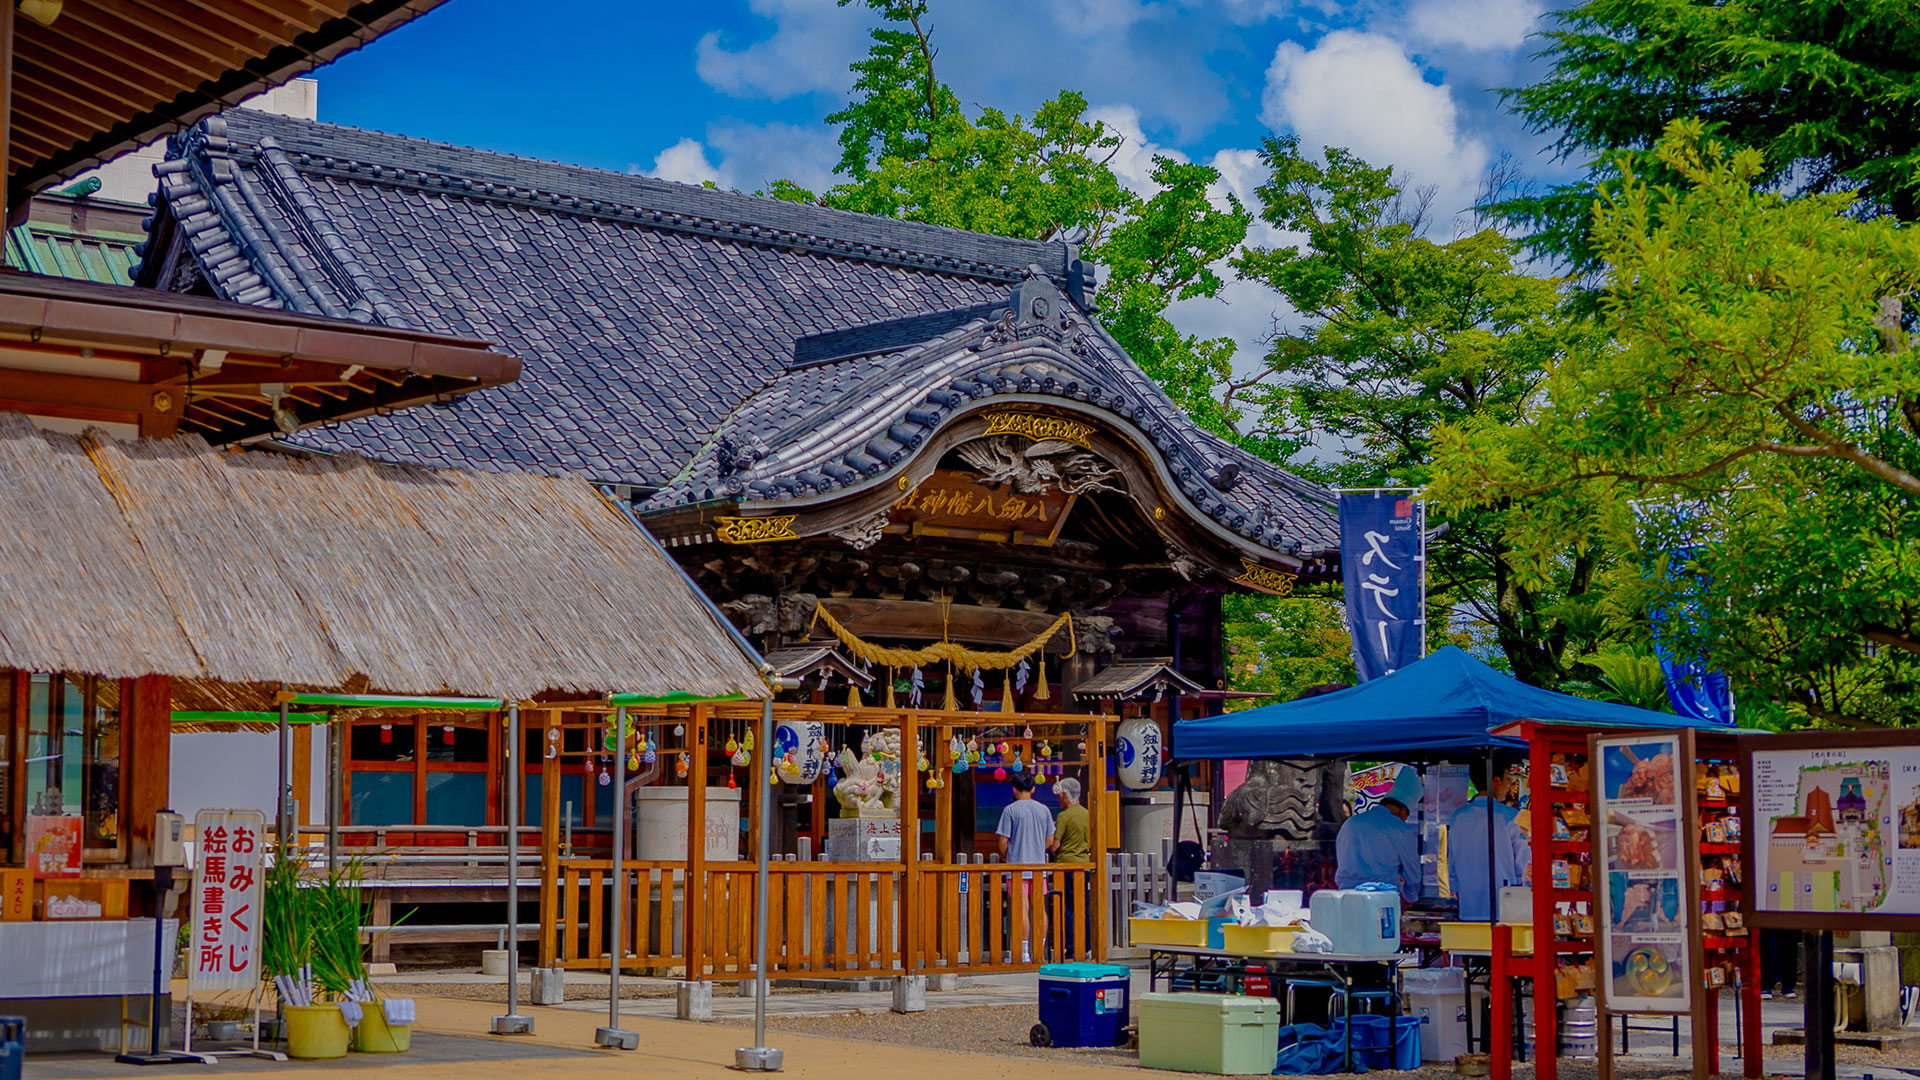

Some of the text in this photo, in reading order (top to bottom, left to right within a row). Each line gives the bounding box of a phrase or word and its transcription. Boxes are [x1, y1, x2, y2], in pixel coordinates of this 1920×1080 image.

[200, 825, 228, 972] 絵馬書き所
[229, 825, 255, 972] おみくじ
